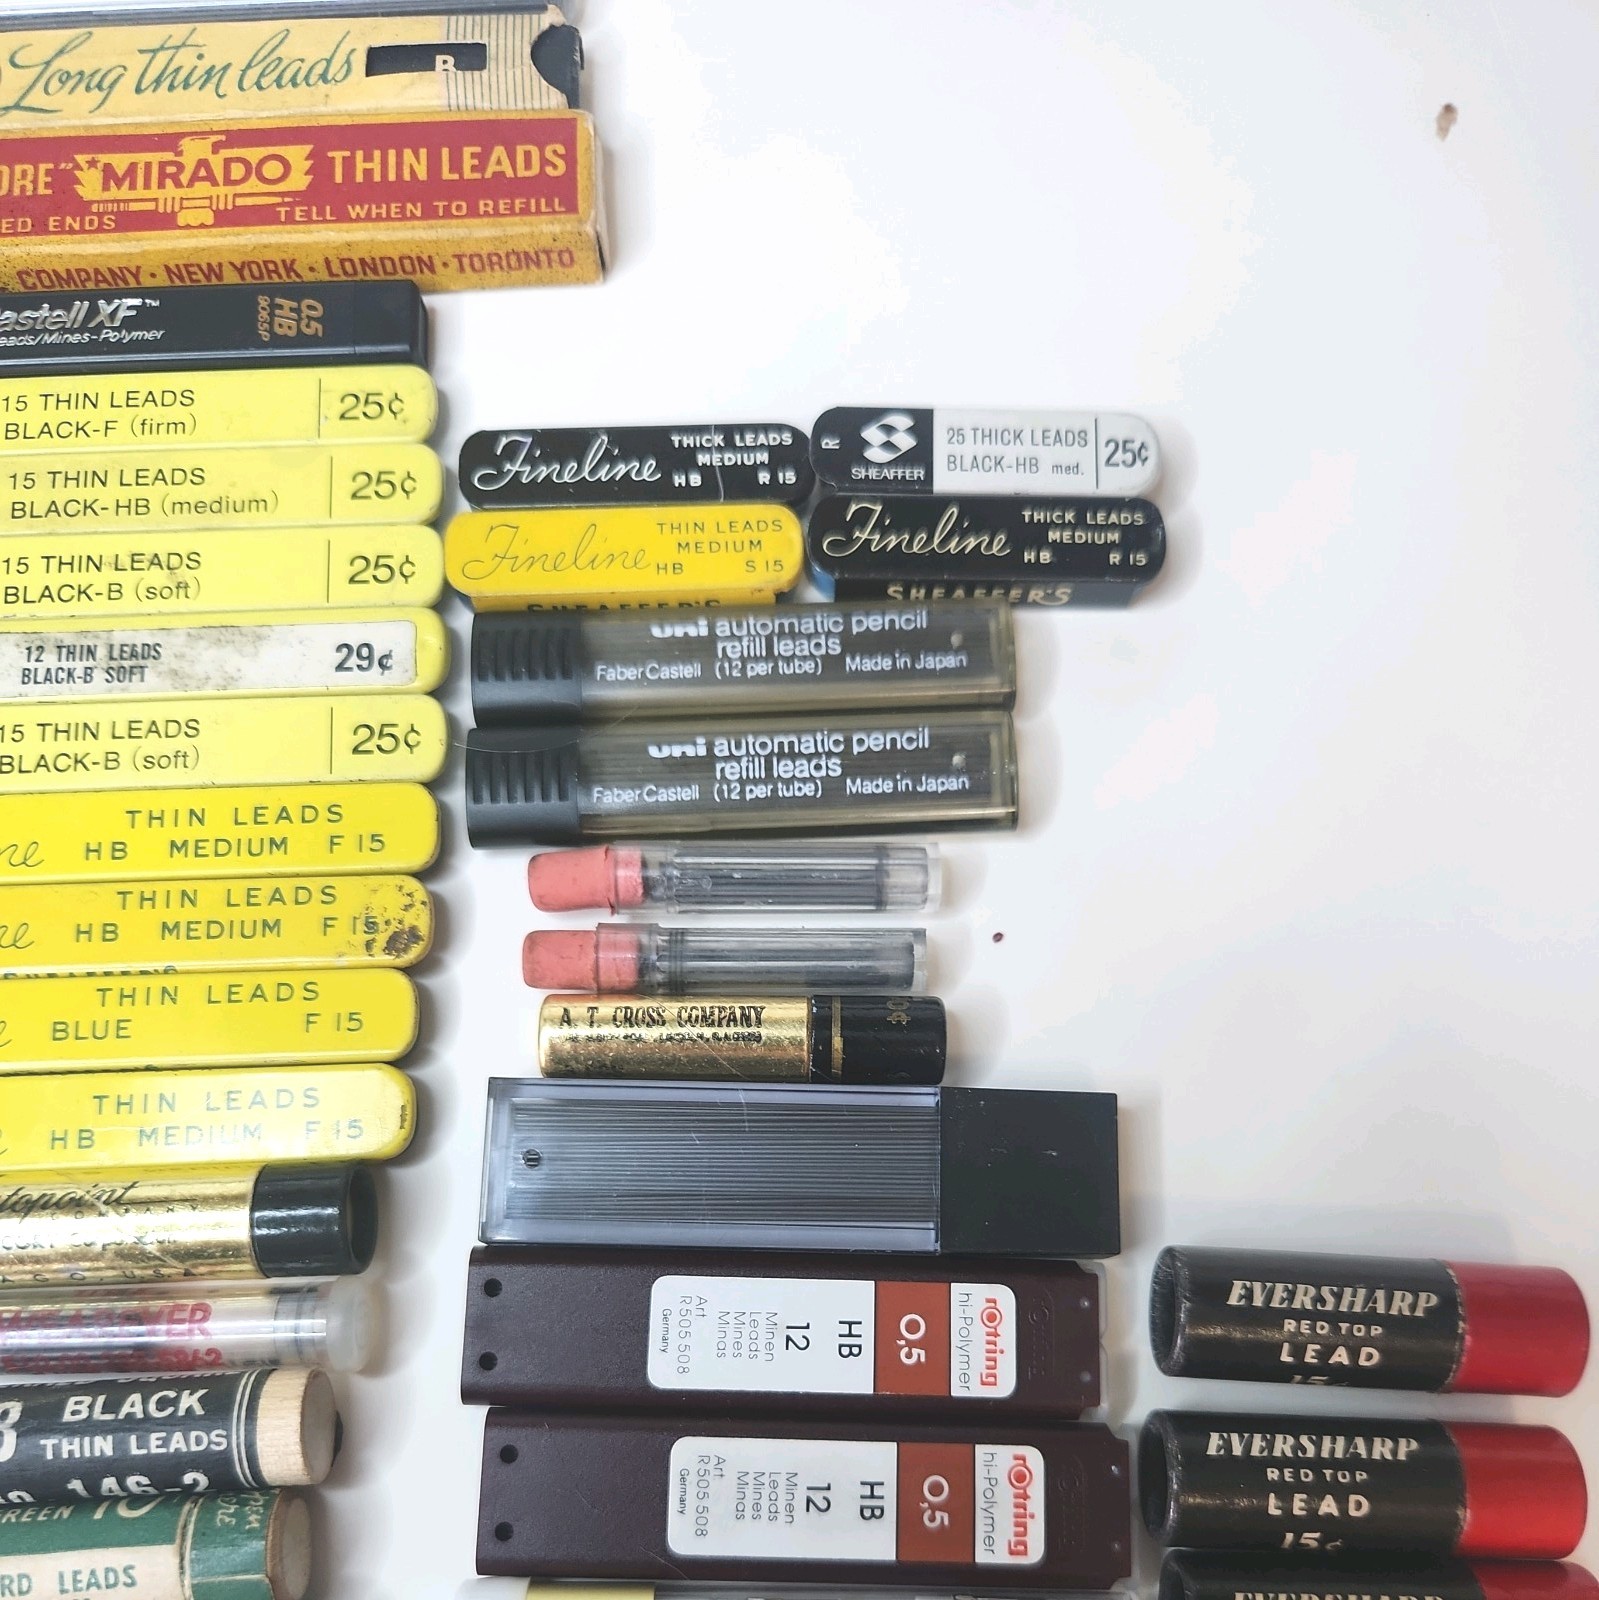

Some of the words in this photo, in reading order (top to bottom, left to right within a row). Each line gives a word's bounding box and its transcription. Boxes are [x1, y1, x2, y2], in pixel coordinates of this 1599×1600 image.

[0, 31, 128, 114] Long
[137, 27, 232, 99] thin
[238, 29, 356, 92] leads
[101, 153, 293, 193] MIRADO
[327, 148, 427, 184] THIN
[441, 144, 567, 181] LEADS
[49, 215, 116, 231] ENDS
[276, 205, 337, 222] TELL
[348, 202, 422, 219] WHEN
[433, 201, 468, 216] TO
[479, 197, 567, 215] REFILL
[16, 265, 142, 291] COMPANY
[165, 261, 224, 285] NEW
[231, 257, 303, 281] YORK
[325, 256, 437, 278] LONDON
[452, 249, 575, 274] TORONTO
[274, 298, 298, 337] HB
[2, 395, 28, 412] 15
[40, 392, 99, 411] THIN
[110, 389, 195, 408] LEADS
[339, 391, 405, 421] 25¢
[4, 421, 118, 440] BLACK-F
[130, 413, 196, 437] (firm)
[947, 429, 965, 446] 25
[972, 428, 1024, 446] THICK
[1031, 430, 1088, 447] LEADS
[822, 435, 840, 449] R
[1105, 439, 1148, 467] 25¢
[472, 435, 662, 490] Fineline
[672, 434, 725, 448] THICK
[735, 431, 793, 447] LEADS
[698, 451, 770, 466] MEDIUM
[948, 455, 1039, 473] BLACK-HB
[1052, 463, 1085, 475] med.
[9, 472, 36, 490] 15
[47, 470, 108, 489] THIN
[119, 467, 205, 487] LEADS
[350, 470, 417, 501] 25¢
[673, 473, 703, 487] HB
[851, 468, 925, 481] SHEAFFER
[162, 490, 279, 517] (medium)
[823, 502, 1011, 556] Fineline
[1023, 511, 1076, 524] THICK
[1087, 511, 1144, 525] LEADS
[1048, 531, 1120, 544] MEDIUM
[462, 523, 652, 580] Fineline
[657, 522, 705, 534] THIN
[717, 520, 784, 533] LEADS
[677, 540, 763, 553] MEDIUM
[1024, 552, 1051, 564] HB
[2, 557, 29, 574] 15
[41, 555, 103, 574] THIN
[114, 552, 201, 571] LEADS
[349, 555, 416, 585] 25¢
[657, 563, 684, 575] HB
[767, 560, 784, 573] 15
[3, 583, 123, 604] BLACK-B
[136, 577, 200, 602] (soft)
[715, 612, 844, 637] automatic
[852, 609, 928, 636] pencil
[26, 645, 44, 662] 12
[57, 644, 97, 662] THIN
[109, 643, 162, 661] LEADS
[335, 642, 394, 673] 29¢
[717, 637, 767, 658] refill
[773, 634, 842, 657] leads
[21, 667, 94, 685] BLACK-B
[105, 666, 148, 683] SOFT
[716, 661, 743, 679] (12
[747, 663, 774, 680] per
[778, 659, 822, 677] tube)
[846, 656, 892, 673] Made
[895, 654, 913, 671] in
[915, 652, 966, 673] Japan
[0, 724, 24, 743] 15
[37, 722, 100, 742] THIN
[111, 719, 200, 740] LEADS
[351, 723, 421, 755] 25¢
[714, 730, 844, 757] automatic
[852, 727, 930, 756] pencil
[0, 752, 120, 774] BLACK-B
[134, 745, 199, 772] (soft)
[716, 758, 767, 779] refill
[773, 756, 842, 778] leads
[714, 783, 743, 801] (12
[746, 785, 774, 802] per
[778, 781, 822, 799] tube)
[846, 778, 893, 795] Made
[897, 776, 913, 793] in
[916, 775, 969, 795] Japan
[126, 808, 207, 829] THIN
[234, 804, 345, 826] LEADS
[85, 841, 128, 861] HB
[170, 836, 288, 859] MEDIUM
[117, 889, 198, 910] THIN
[226, 885, 337, 907] LEADS
[75, 923, 119, 942] HB
[161, 919, 281, 940] MEDIUM
[97, 985, 178, 1007] THIN
[208, 982, 319, 1004] LEADS
[52, 1019, 132, 1041] BLUE
[613, 1006, 666, 1028] CROSS
[677, 1005, 766, 1028] COMPANY
[93, 1093, 176, 1114] THIN
[206, 1088, 320, 1111] LEADS
[51, 1130, 95, 1149] HB
[139, 1124, 262, 1147] MEDIUM
[1226, 1280, 1438, 1316] EVERSHARP
[659, 1308, 672, 1353] Germany
[717, 1311, 730, 1358] Minas
[733, 1311, 746, 1358] Mines
[749, 1312, 762, 1360] Leads
[765, 1312, 778, 1362] Minen
[786, 1322, 810, 1351] 12
[838, 1320, 862, 1358] HB
[896, 1313, 926, 1365] 0,5
[956, 1293, 973, 1391] hi-Polymer
[1284, 1319, 1330, 1334] RED
[1338, 1322, 1383, 1337] TOP
[1280, 1342, 1381, 1366] LEAD
[62, 1389, 209, 1422] BLACK
[40, 1435, 113, 1460] THIN
[130, 1429, 227, 1454] LEADS
[1206, 1432, 1419, 1460] EVERSHARP
[1267, 1468, 1314, 1482] RED
[1323, 1469, 1368, 1483] TOP
[677, 1468, 690, 1515] Germany
[736, 1471, 749, 1520] Minas
[752, 1471, 765, 1520] Mines
[769, 1472, 781, 1522] Leads
[785, 1472, 798, 1524] Minen
[806, 1483, 831, 1513] 12
[860, 1481, 884, 1520] HB
[920, 1474, 949, 1528] 0,5
[980, 1452, 997, 1554] hi-Polymer
[1268, 1492, 1370, 1517] LEAD
[58, 1564, 137, 1595] LEADS
